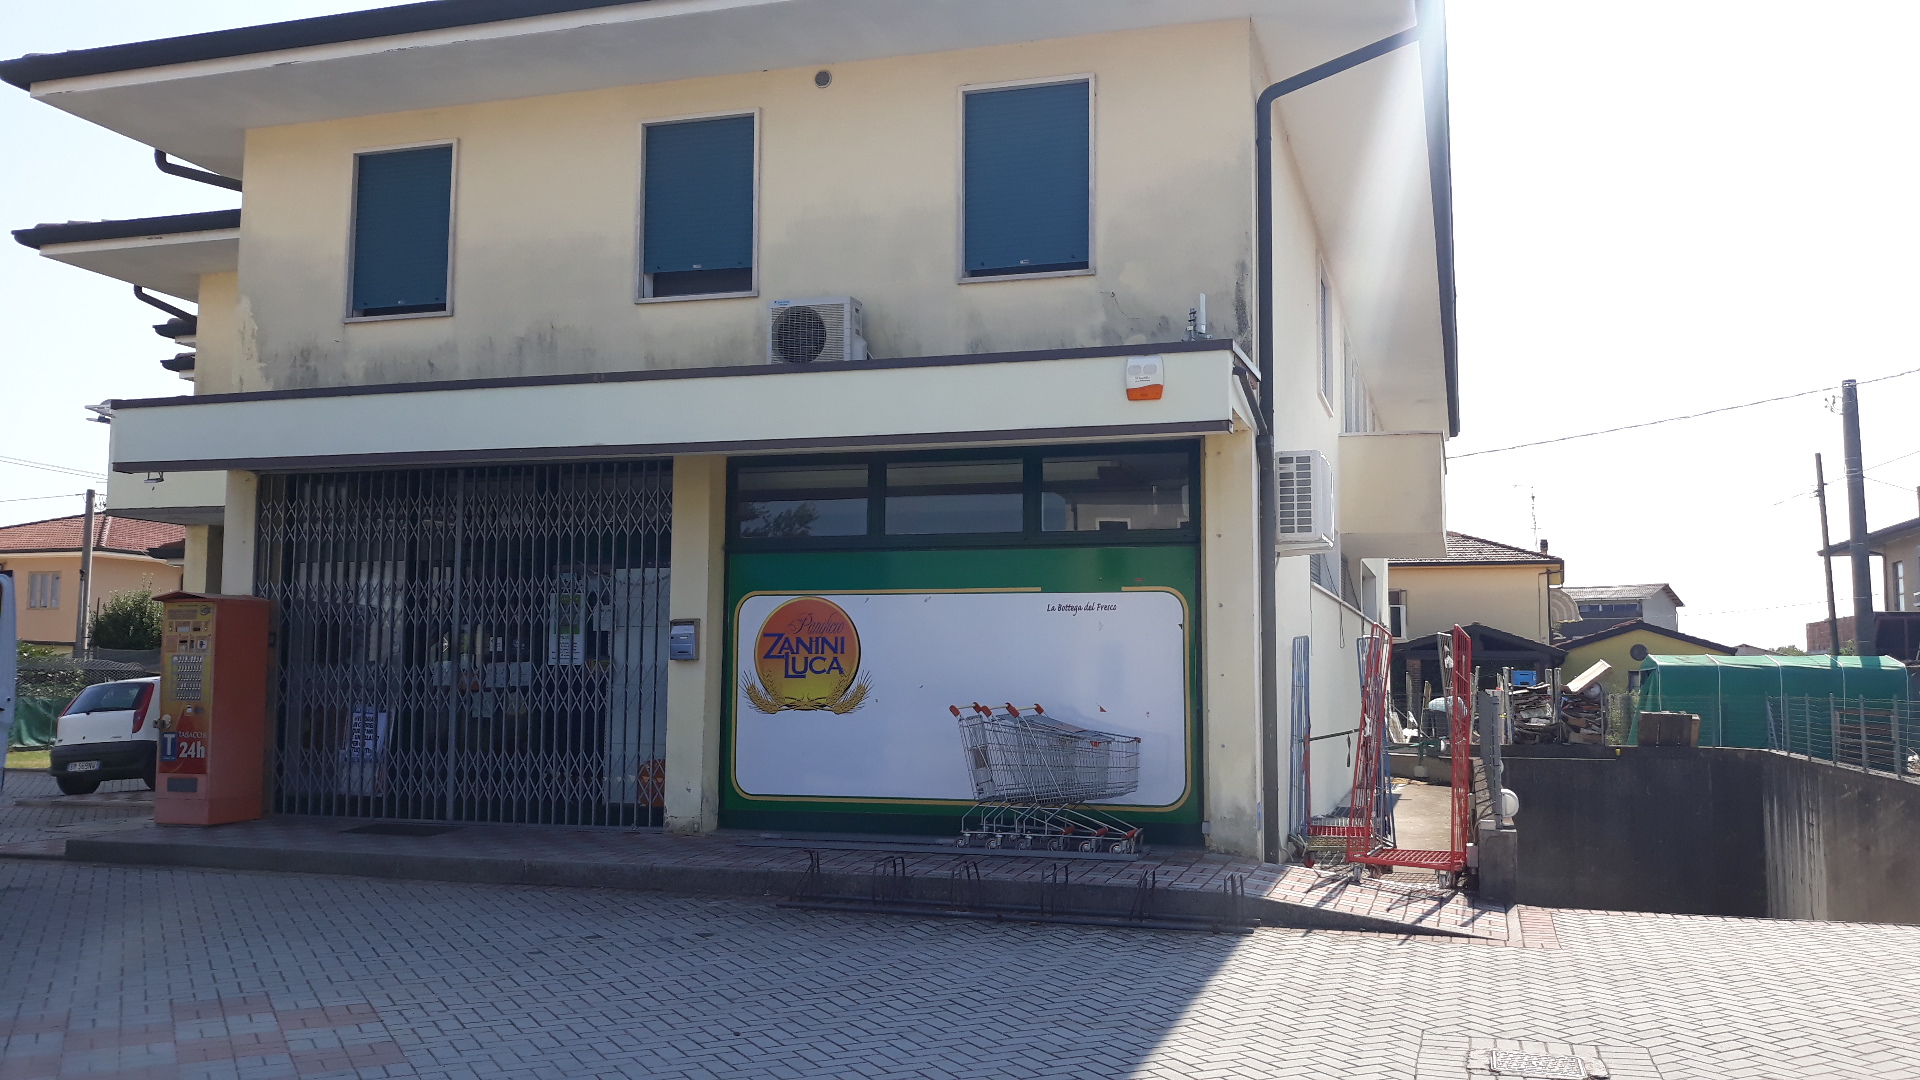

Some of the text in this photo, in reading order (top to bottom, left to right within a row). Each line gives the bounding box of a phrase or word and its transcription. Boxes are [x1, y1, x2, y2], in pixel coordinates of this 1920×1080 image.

[1047, 602, 1117, 616] La Bottega del Fresco
[763, 633, 846, 659] ZANINI
[784, 651, 845, 679] LUCA
[163, 733, 176, 756] T
[178, 741, 206, 759] 24h
